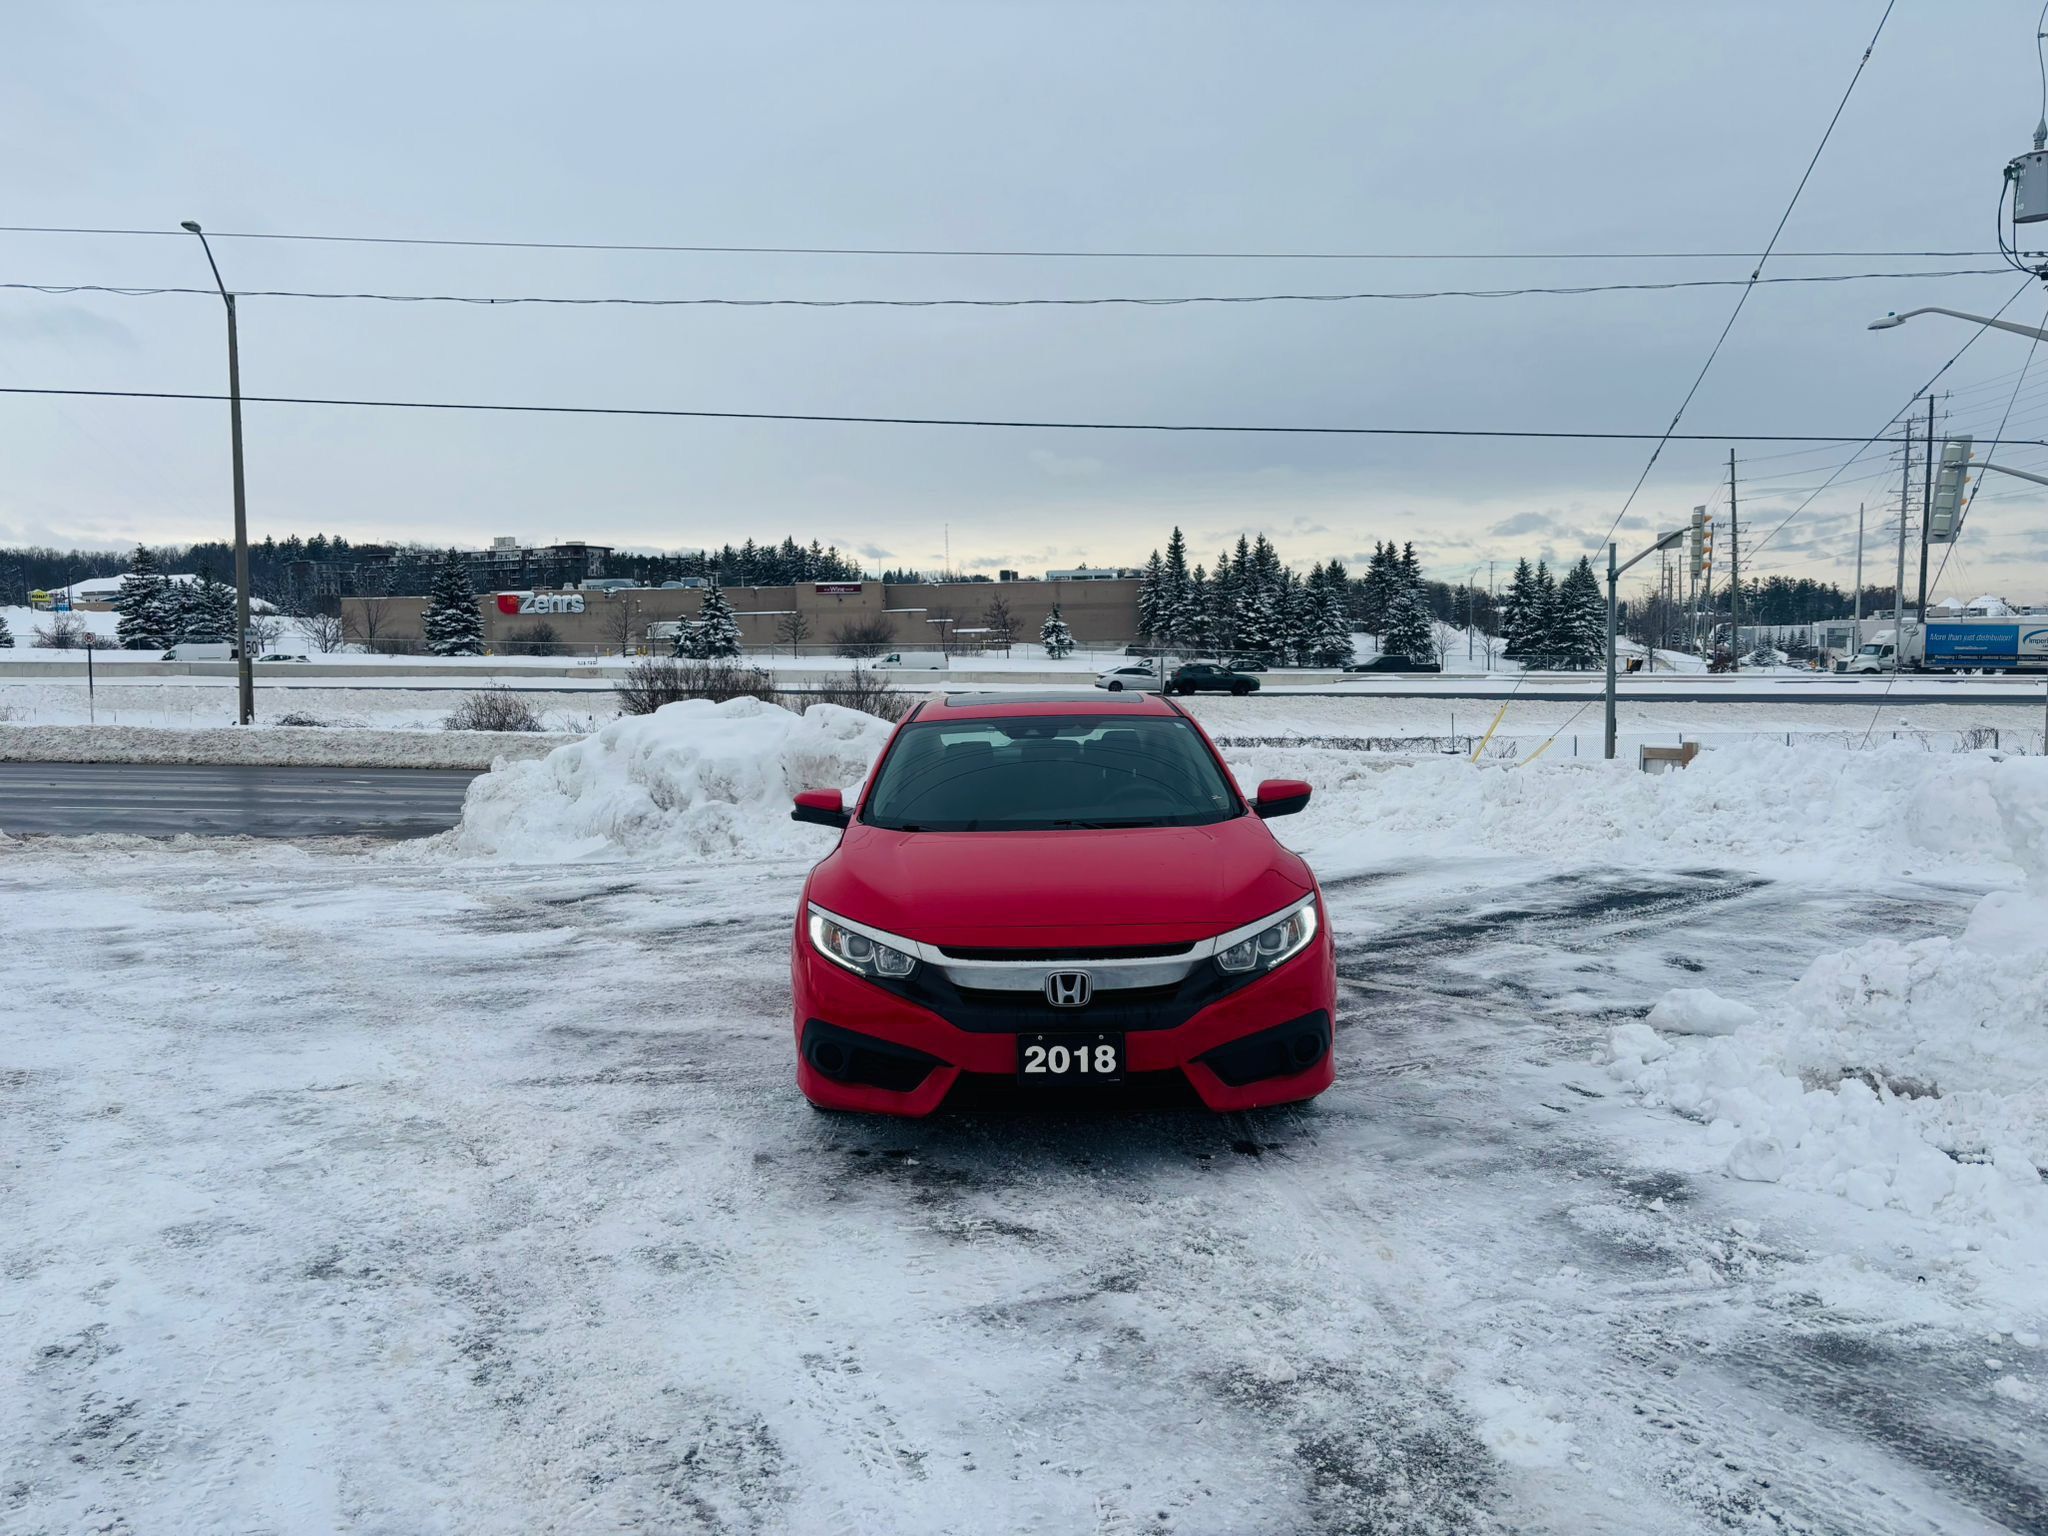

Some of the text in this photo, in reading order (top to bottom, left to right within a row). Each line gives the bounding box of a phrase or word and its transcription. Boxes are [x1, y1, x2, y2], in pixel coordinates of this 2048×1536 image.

[518, 591, 585, 614] Zehrs
[1929, 633, 1947, 641] More
[246, 641, 258, 654] 50
[1024, 1044, 1117, 1074] 2018
